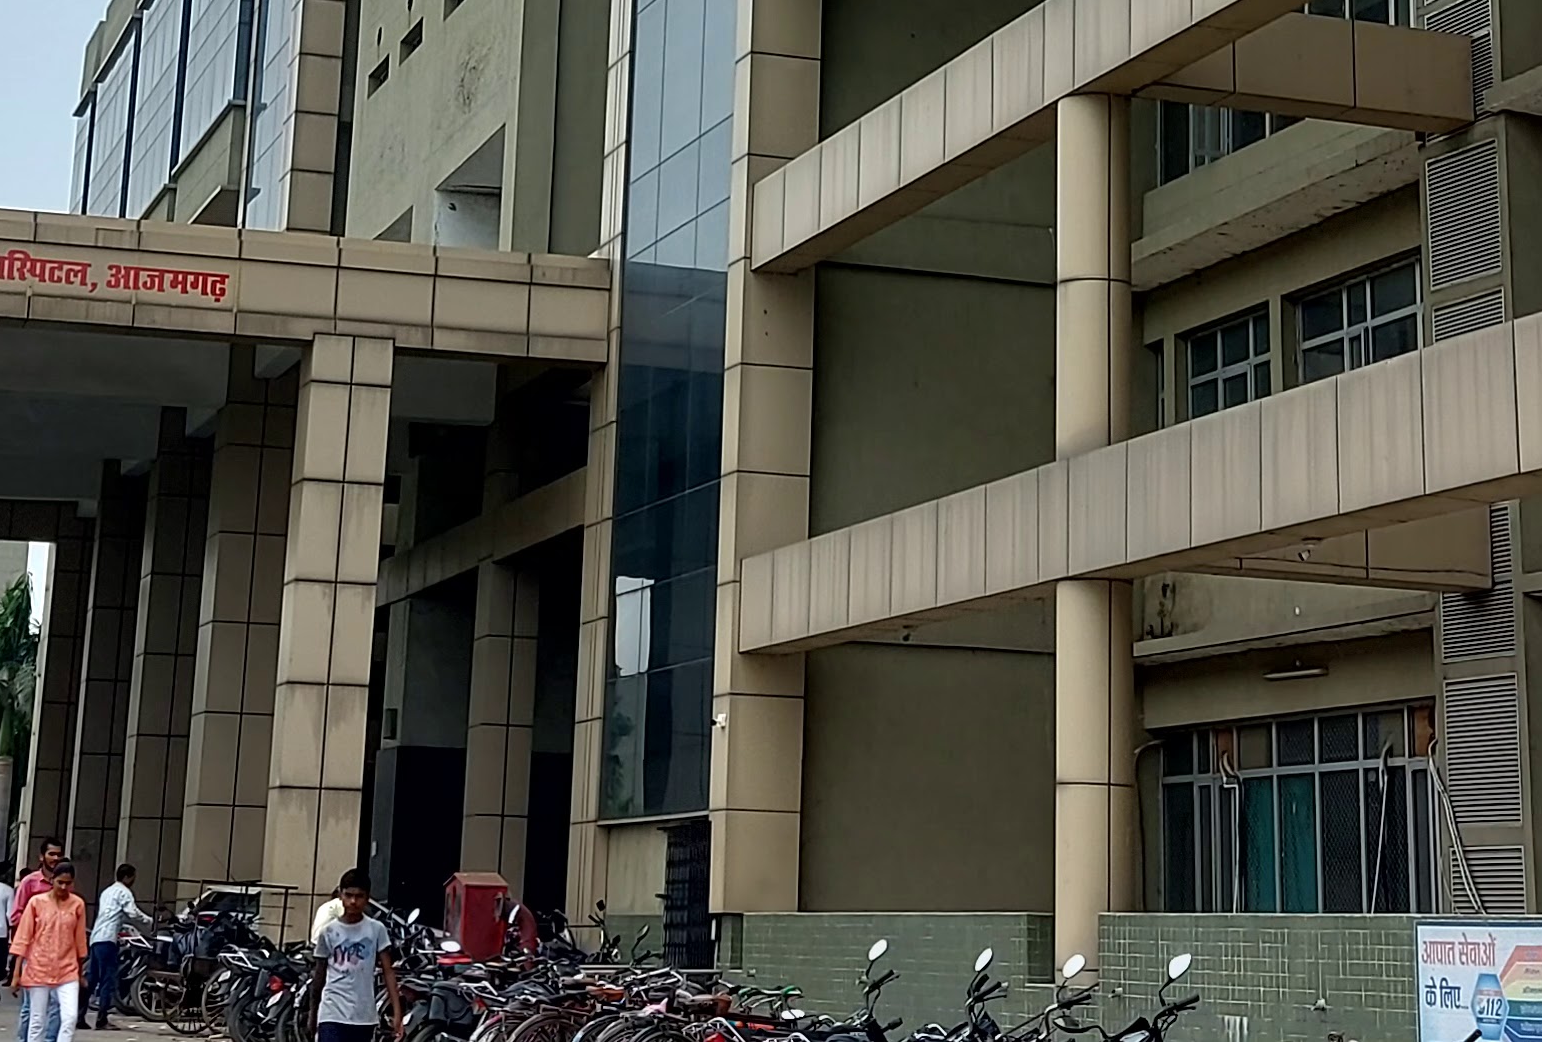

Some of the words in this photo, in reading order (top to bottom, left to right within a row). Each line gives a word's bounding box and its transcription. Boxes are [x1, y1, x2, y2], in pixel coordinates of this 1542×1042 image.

[105, 264, 230, 303] आजमगढ़
[1421, 940, 1456, 966] आपात
[1458, 931, 1497, 967] सेवाओं
[1424, 976, 1437, 1007] के
[1485, 998, 1503, 1017] 112
